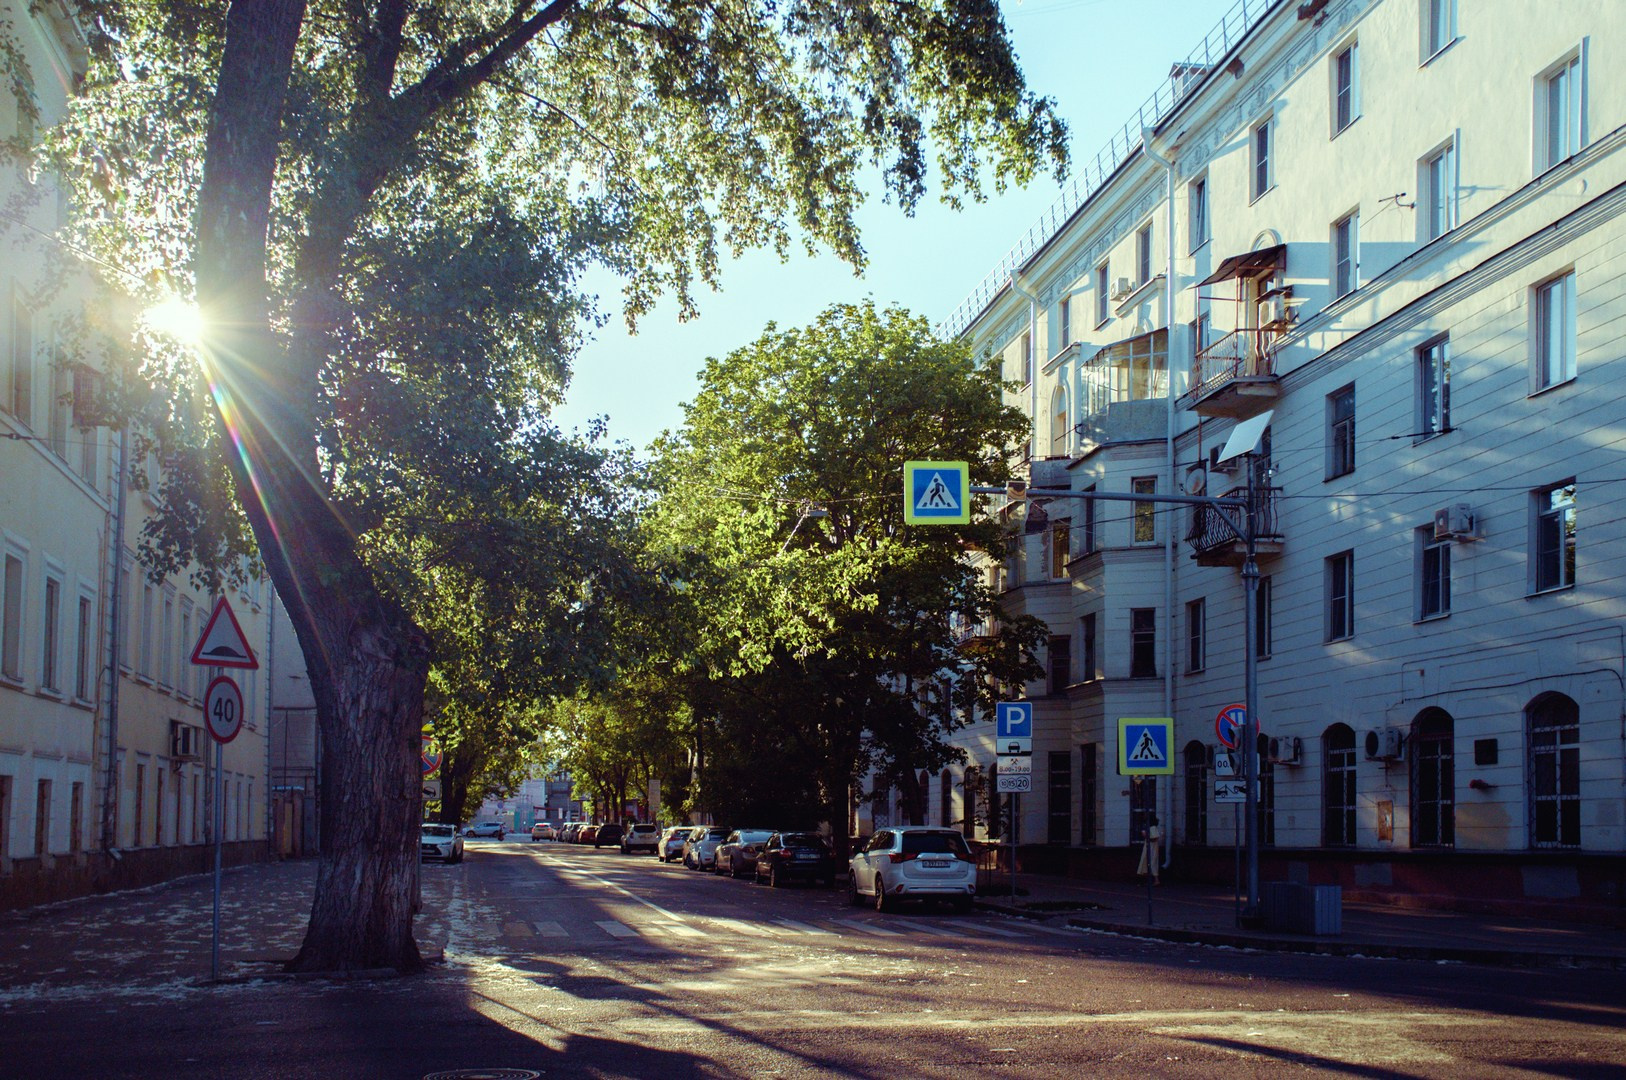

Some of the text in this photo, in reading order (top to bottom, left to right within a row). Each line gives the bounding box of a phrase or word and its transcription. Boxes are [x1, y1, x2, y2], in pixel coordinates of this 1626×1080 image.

[213, 697, 234, 723] 40
[1006, 706, 1025, 733] P
[1008, 780, 1016, 788] 15
[1017, 779, 1028, 788] 20
